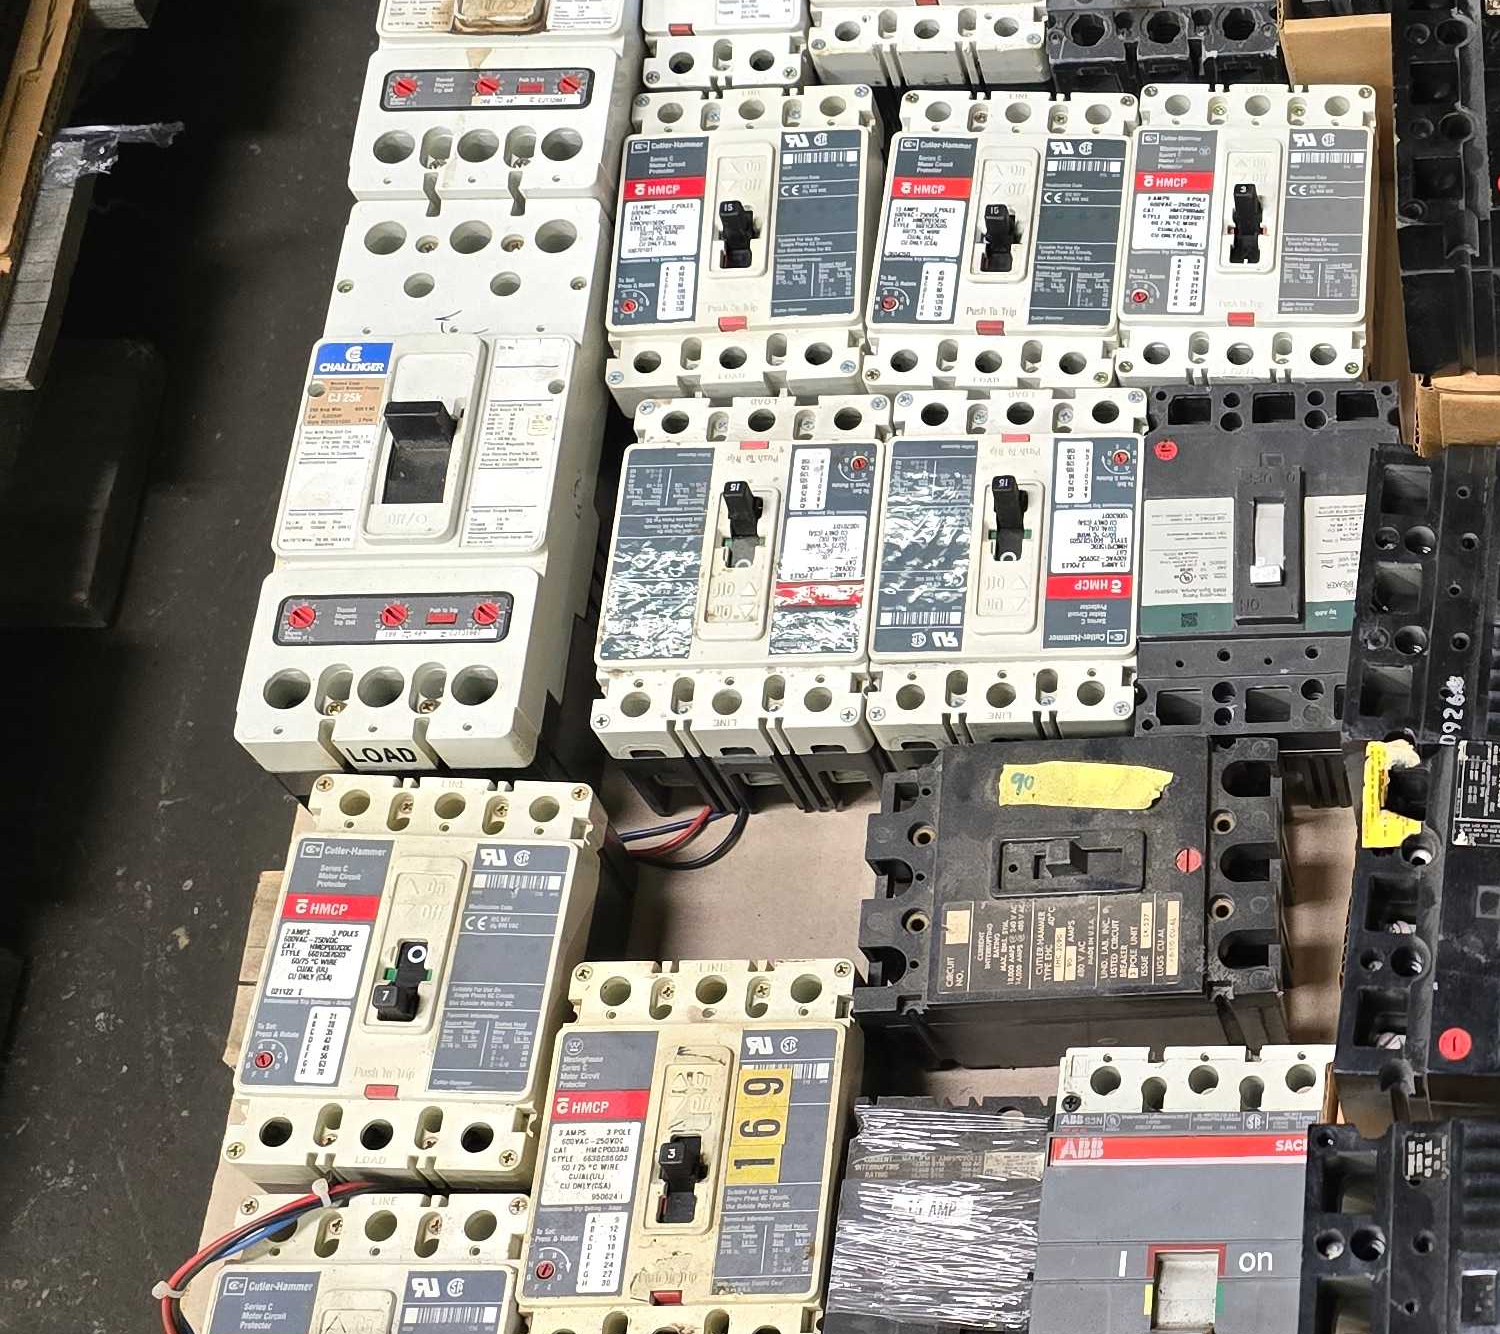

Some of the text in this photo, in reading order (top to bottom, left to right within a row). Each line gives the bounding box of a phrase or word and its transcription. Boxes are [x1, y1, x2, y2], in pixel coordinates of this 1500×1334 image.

[1155, 178, 1188, 188] HMCP
[647, 184, 680, 196] HMCP
[913, 185, 946, 194] HMCP
[723, 203, 733, 212] 15
[990, 206, 1000, 214] 15
[318, 361, 385, 373] CHALLENGER
[998, 478, 1009, 487] 15
[1073, 578, 1108, 591] HMCP
[1048, 632, 1107, 644] Cutler-Hammer
[346, 744, 417, 765] LOAD
[1010, 772, 1034, 795] 90
[323, 845, 388, 857] Cutler-Hammer
[309, 903, 349, 916] HMCP
[381, 990, 389, 1002] 7
[571, 1101, 609, 1114] HMCP
[1061, 1114, 1084, 1127] ABB
[667, 1148, 676, 1159] 3
[1059, 1137, 1104, 1161] ABB
[600, 1163, 619, 1171] WIRE
[1238, 1250, 1273, 1273] on
[249, 1281, 313, 1292] Cutler-Hammer
[243, 1302, 263, 1311] Series
[241, 1311, 287, 1320] Motor Circuit
